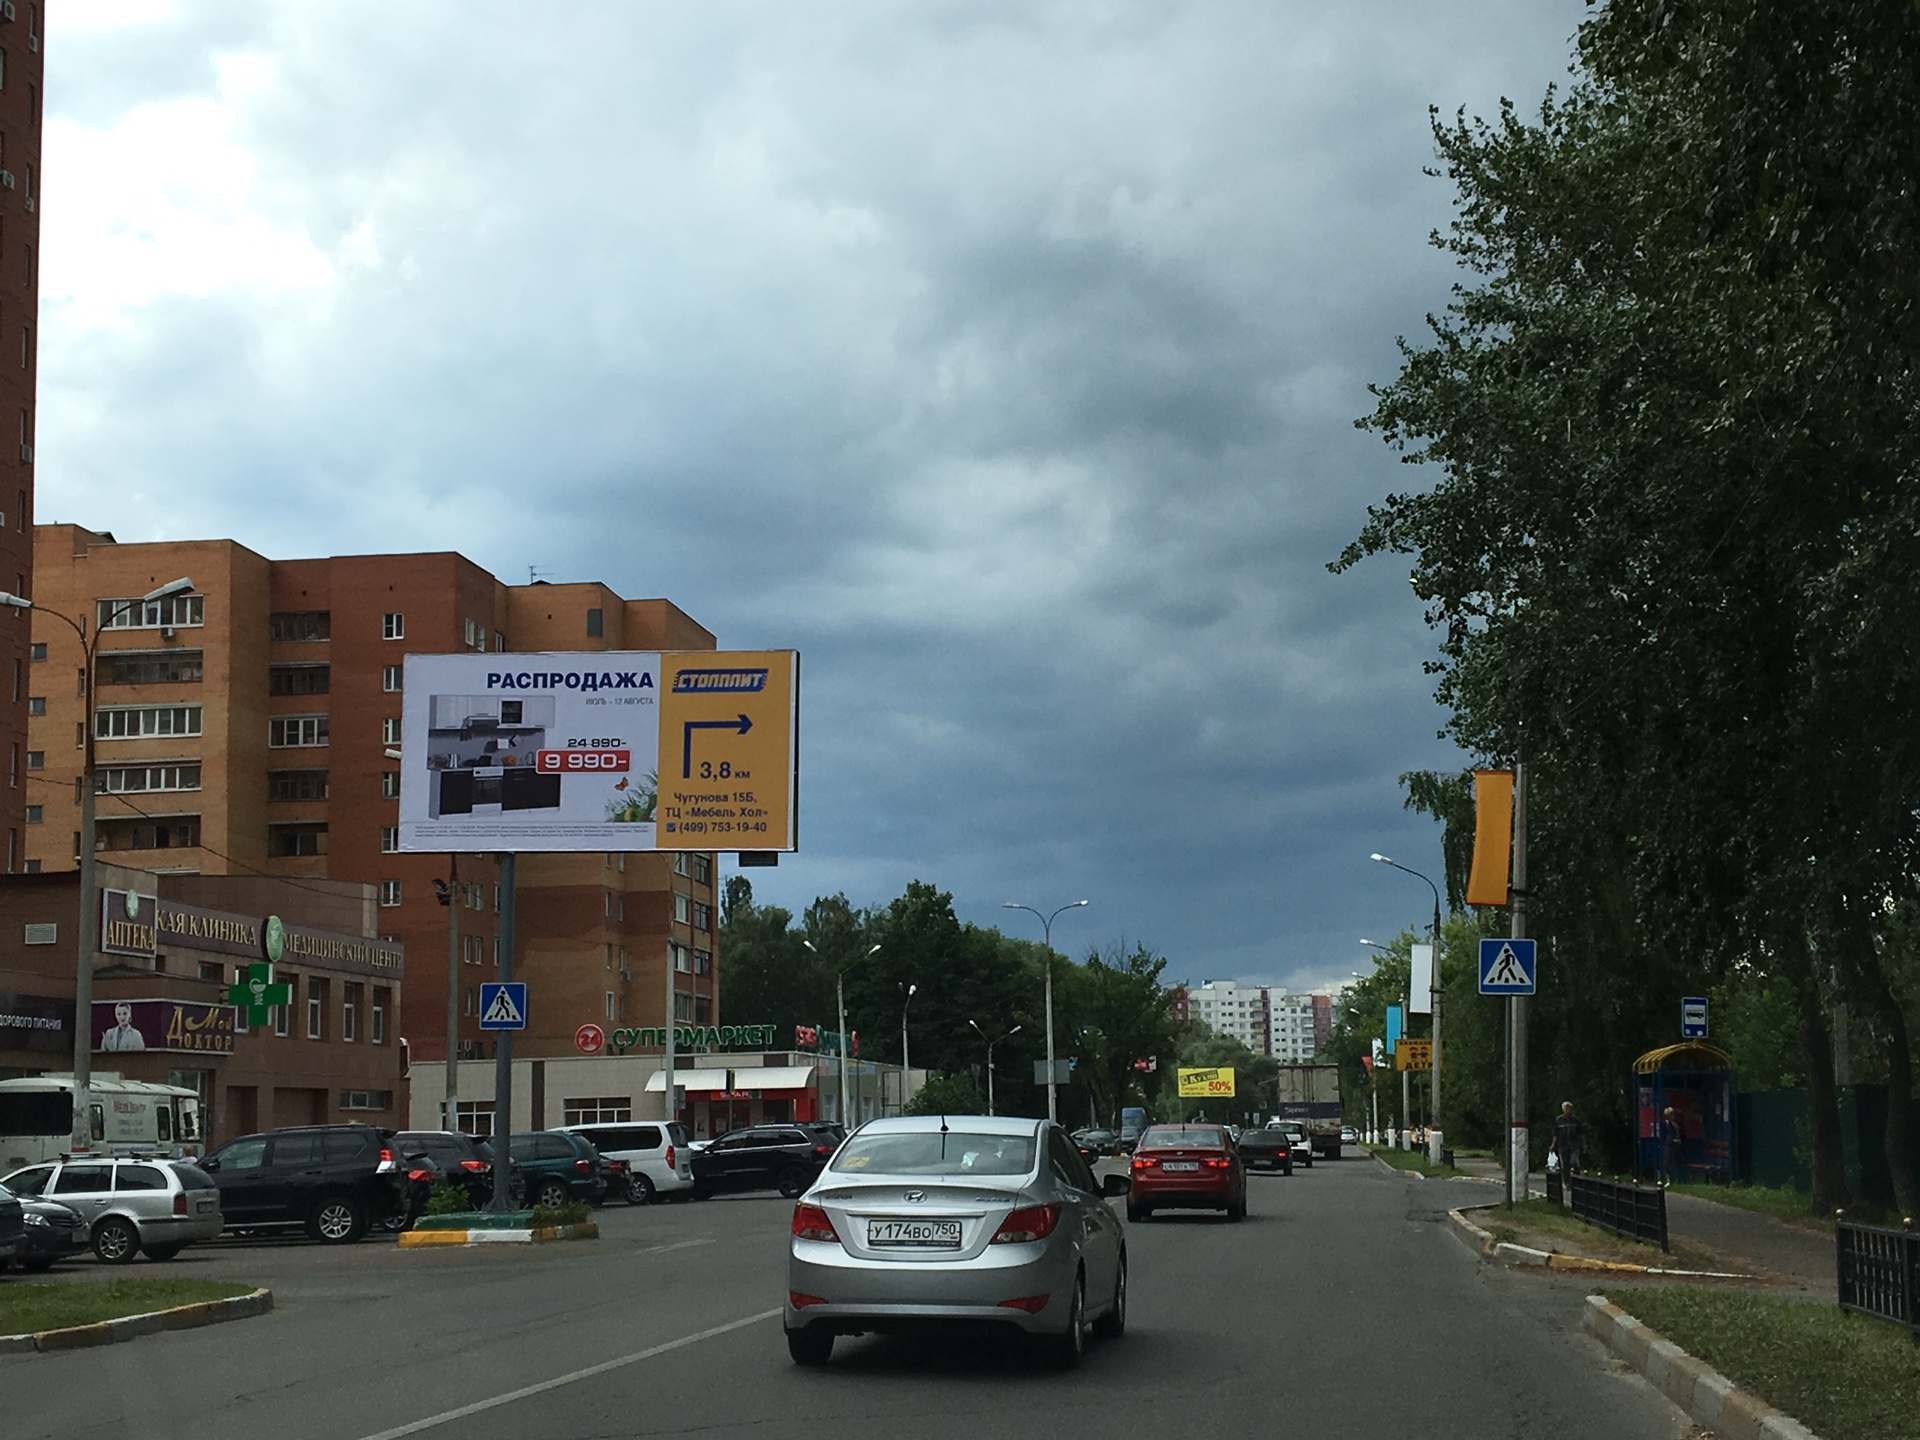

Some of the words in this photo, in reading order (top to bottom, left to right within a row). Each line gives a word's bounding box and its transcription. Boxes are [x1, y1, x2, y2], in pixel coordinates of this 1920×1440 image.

[487, 672, 654, 692] РАСПРОДАЖА
[624, 697, 654, 705] АВГУСТА
[568, 738, 587, 748] 24
[545, 753, 561, 769] 9
[700, 761, 731, 782] 3,8
[674, 792, 729, 805] Чугунова
[665, 807, 681, 819] ТЦ
[685, 807, 736, 818] «Мебель
[739, 807, 768, 818] Хол»
[679, 821, 708, 834] (499)
[711, 821, 767, 832] 753-19-40
[106, 920, 155, 950] АПТЕКА
[189, 914, 257, 946] КЛИНИКА
[283, 932, 368, 963] МЕДИЦИНСКИЙ
[371, 948, 402, 969] ЦЕНТР
[612, 1024, 776, 1048] СУПЕРМАРКЕТ
[1208, 1080, 1232, 1092] 50%
[874, 1223, 931, 1239] У174ВО
[934, 1223, 956, 1235] 750
